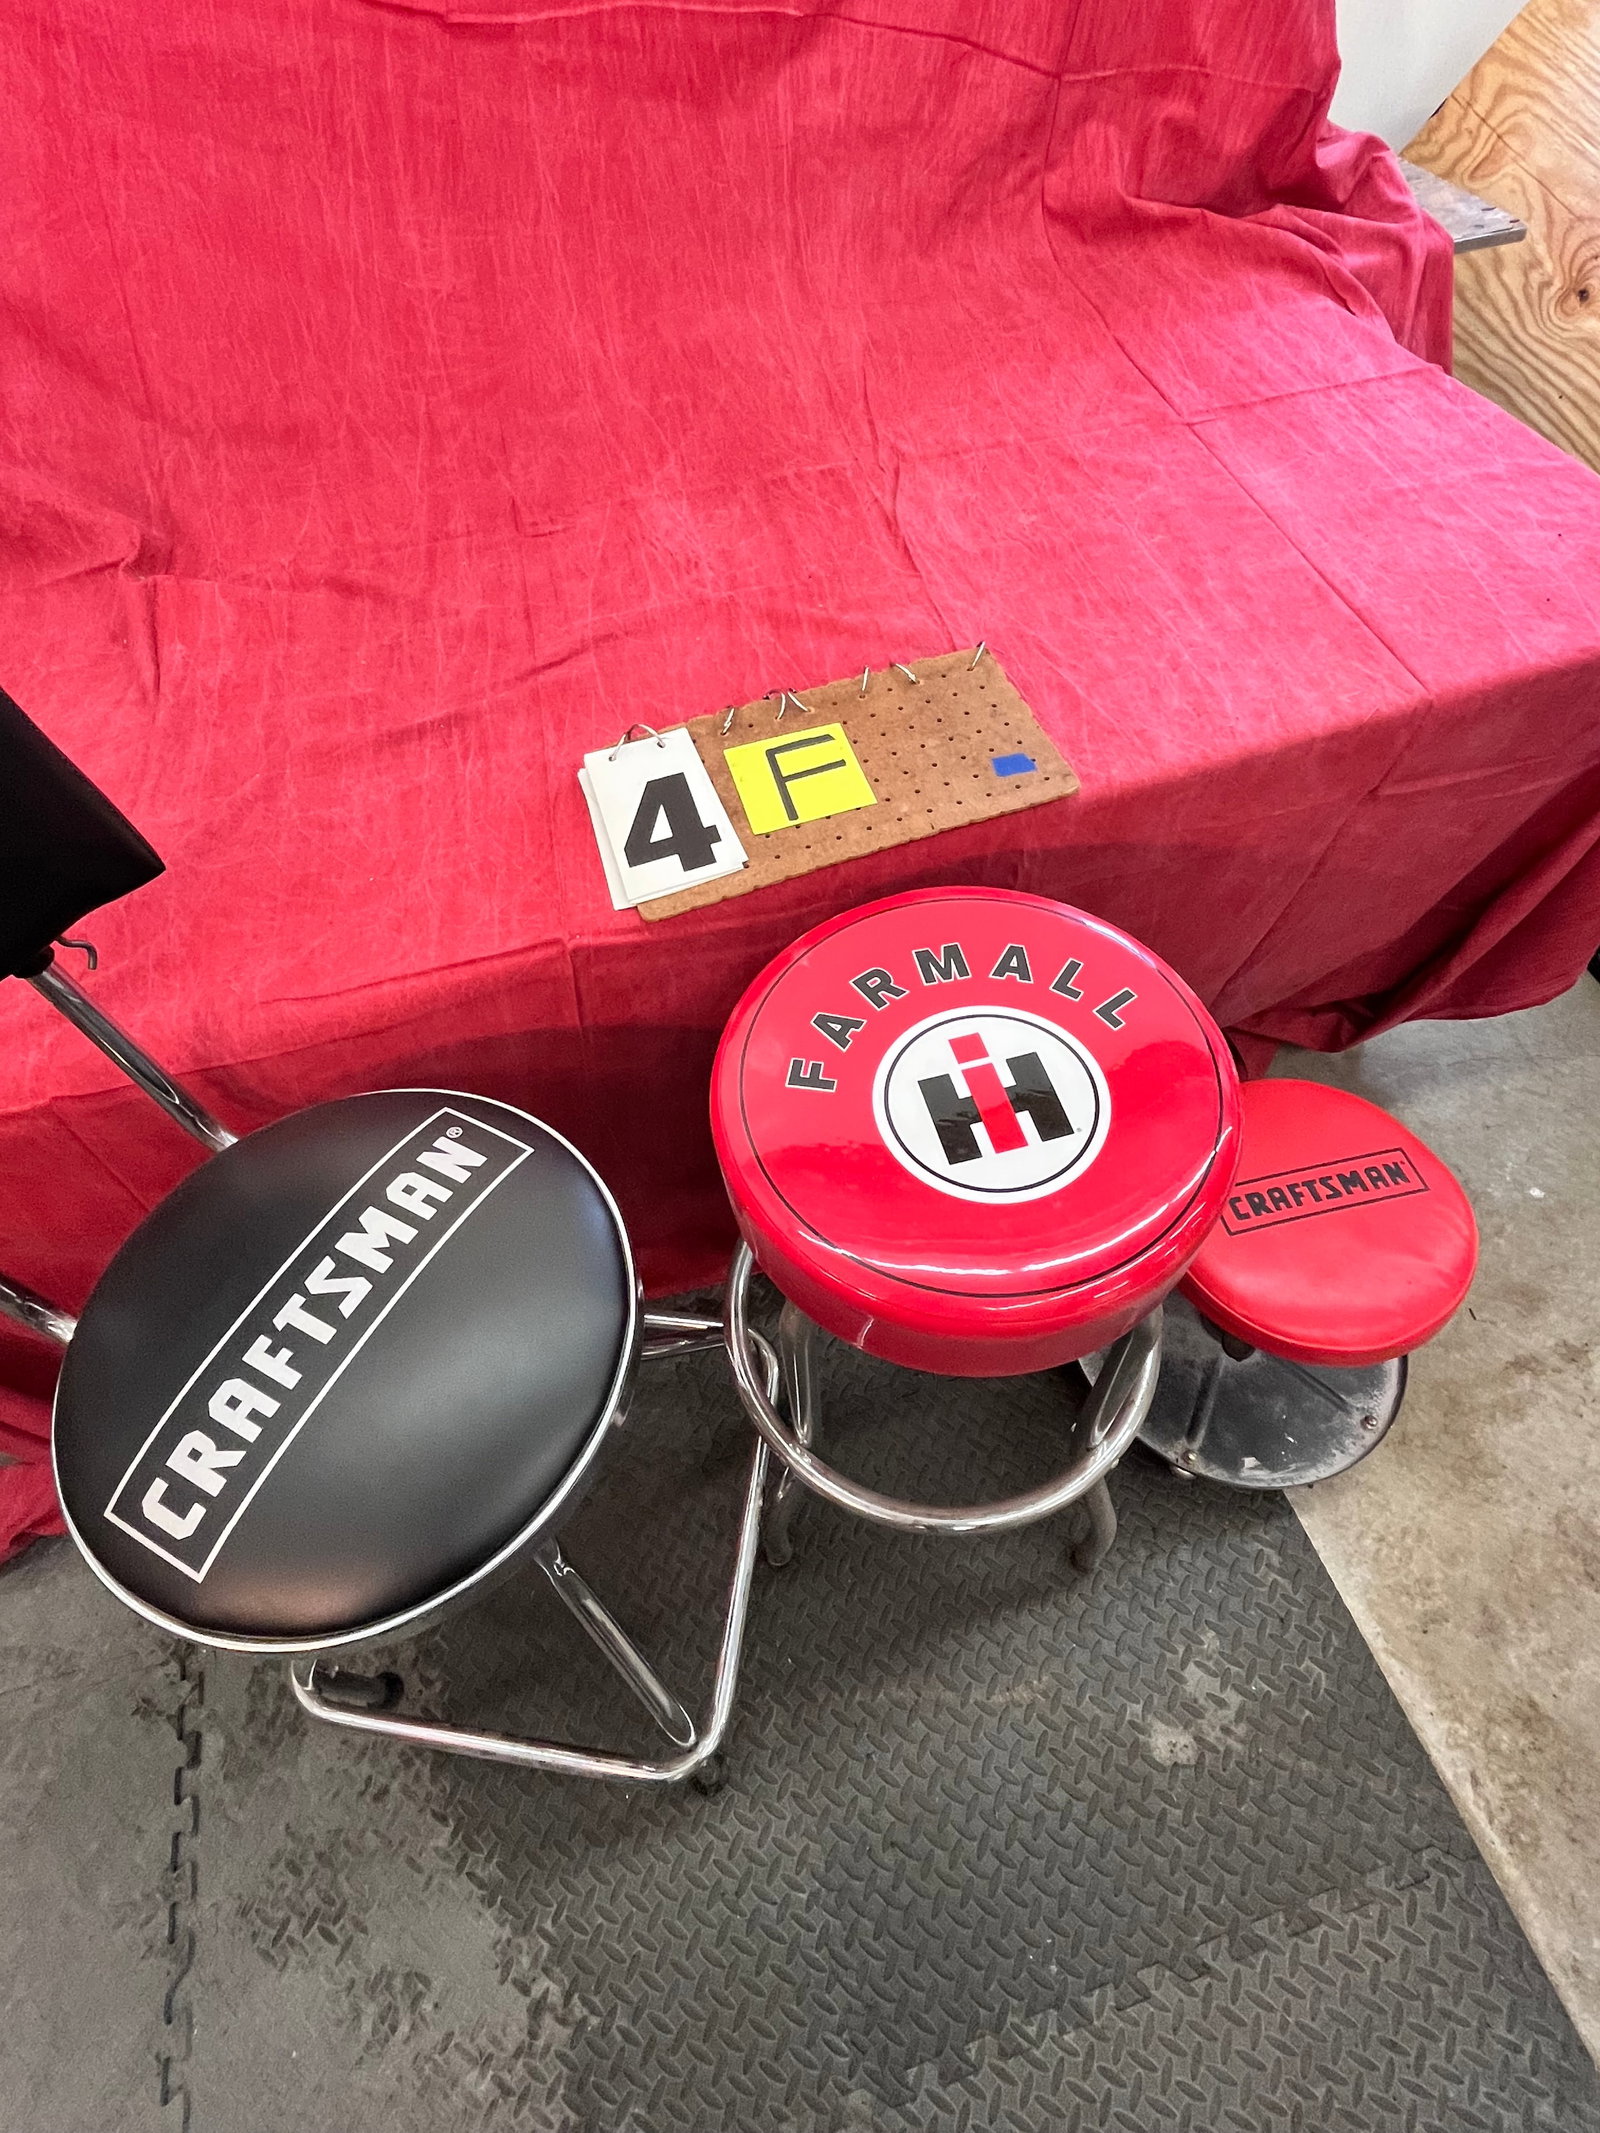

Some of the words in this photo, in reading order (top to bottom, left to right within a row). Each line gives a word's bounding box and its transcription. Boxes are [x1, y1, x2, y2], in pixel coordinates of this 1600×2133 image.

[624, 772, 722, 872] 4
[766, 734, 847, 822] F
[785, 941, 1139, 1094] FARMALL
[1228, 1160, 1411, 1221] CRAFTSMAN
[141, 1134, 488, 1542] CRAFTSMAN
